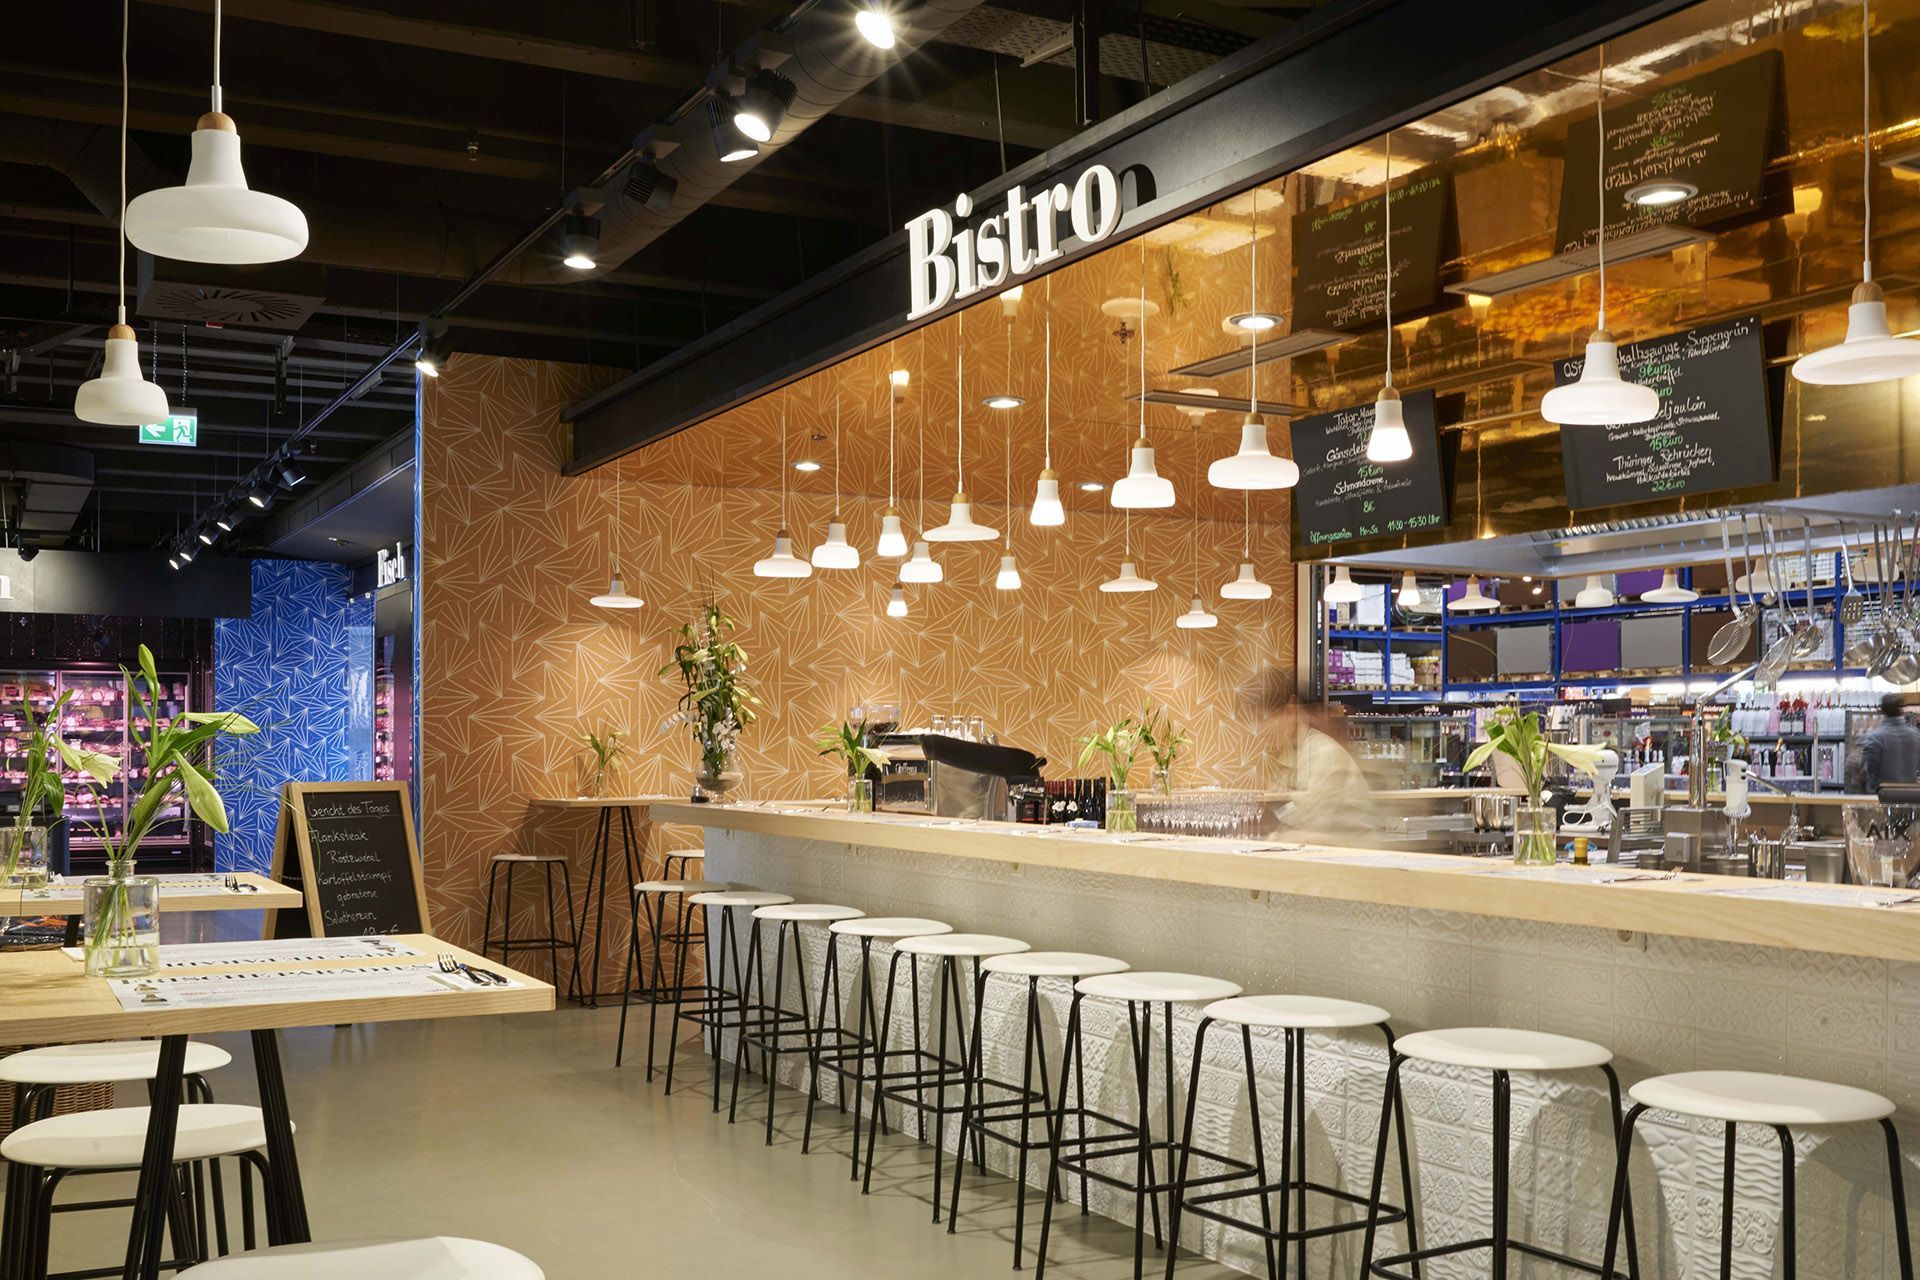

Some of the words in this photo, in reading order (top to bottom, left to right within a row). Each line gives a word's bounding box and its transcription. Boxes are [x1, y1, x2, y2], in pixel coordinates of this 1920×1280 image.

[905, 164, 1122, 321] Bistro
[377, 541, 407, 588] Fisch
[347, 802, 362, 814] des
